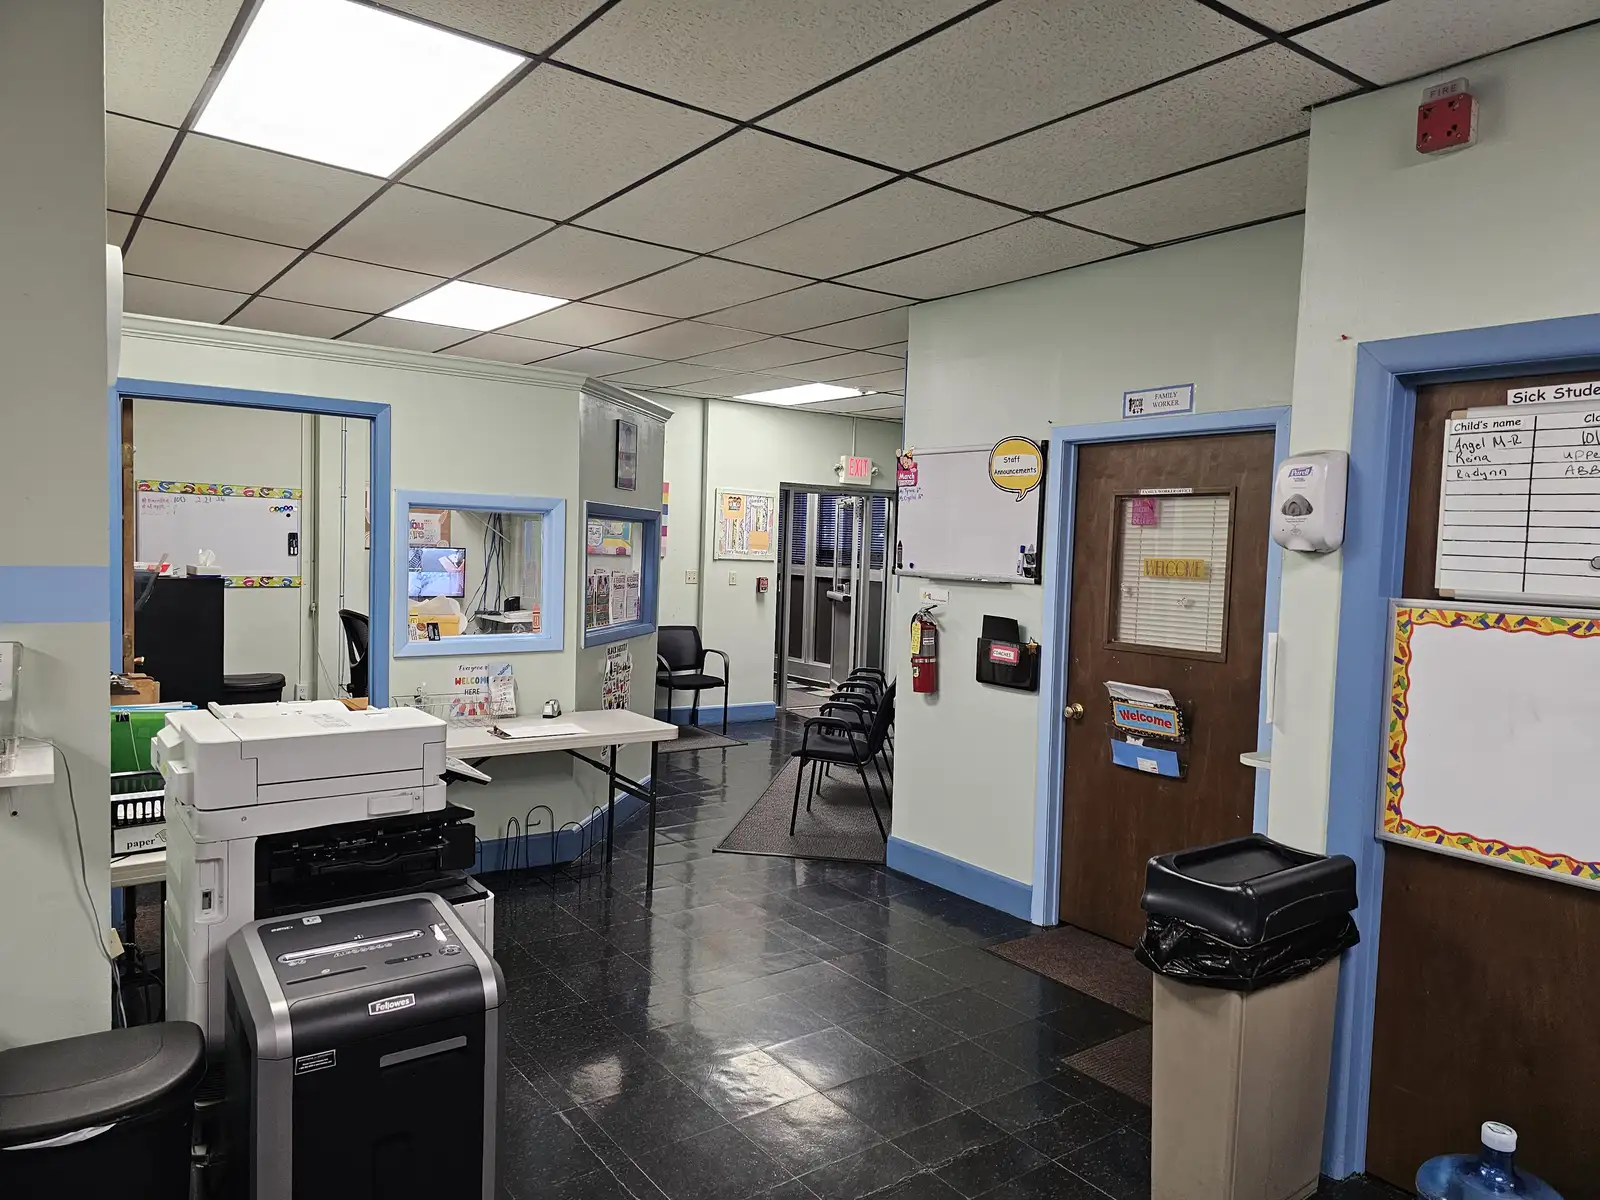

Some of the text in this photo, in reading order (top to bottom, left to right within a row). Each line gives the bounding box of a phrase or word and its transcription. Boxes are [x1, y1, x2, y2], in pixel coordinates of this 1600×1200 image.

[1430, 84, 1457, 98] FIRE
[1155, 391, 1178, 400] FAMILY
[1512, 383, 1600, 404] Sick Stude
[1152, 399, 1180, 408] WORKER
[1454, 419, 1521, 432] Child's name
[1455, 437, 1485, 453] Angel
[1003, 455, 1020, 463] Staff
[1456, 452, 1491, 464] Reina
[848, 458, 868, 477] EXIT
[994, 467, 1037, 475] Announcements
[898, 472, 914, 480] March
[1145, 560, 1202, 578] WELCOME
[993, 650, 1011, 658] COACHES
[464, 688, 480, 696] HERE
[1119, 709, 1172, 729] Welcome
[127, 838, 155, 850] paper
[375, 997, 410, 1012] Fellowes
